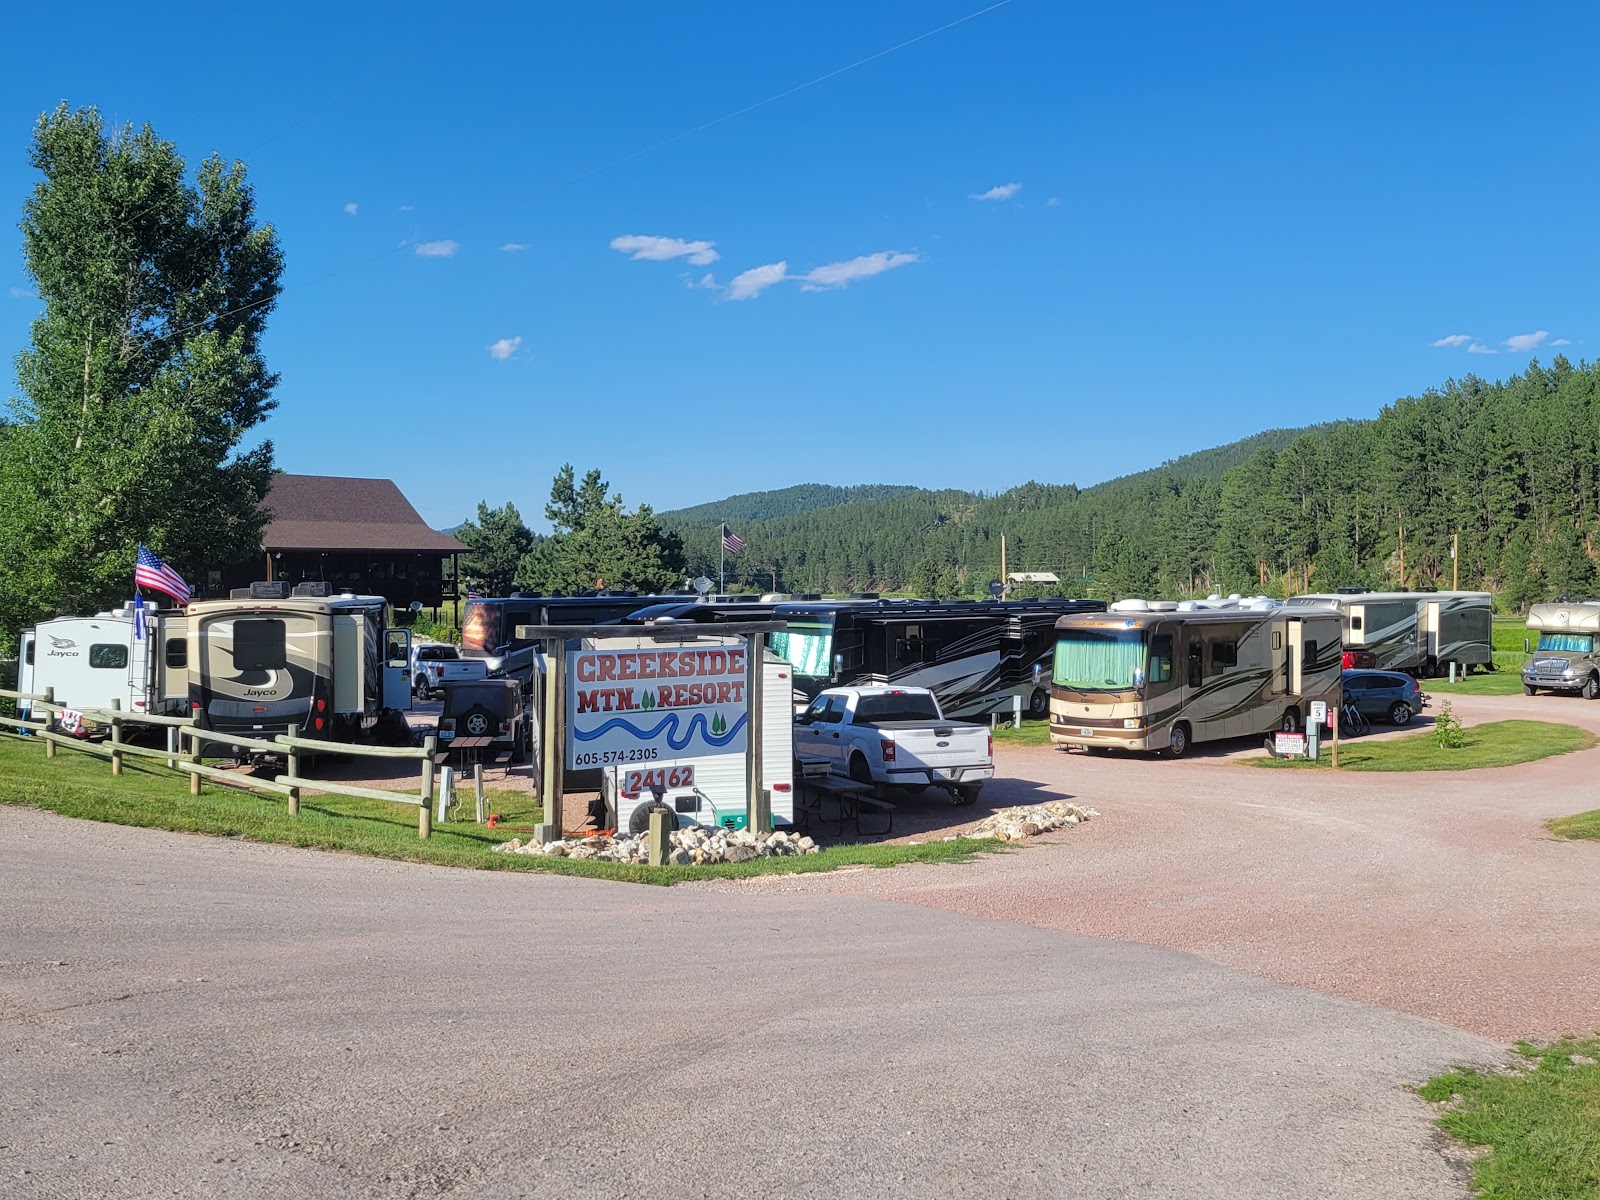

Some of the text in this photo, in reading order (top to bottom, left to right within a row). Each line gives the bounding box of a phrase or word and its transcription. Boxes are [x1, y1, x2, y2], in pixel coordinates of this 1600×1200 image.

[576, 649, 745, 682] CREEKSIDE
[243, 689, 277, 697] Jayco
[577, 680, 745, 713] MTN. RESORT
[575, 747, 658, 765] 605-574-2305
[630, 767, 693, 792] 24162
